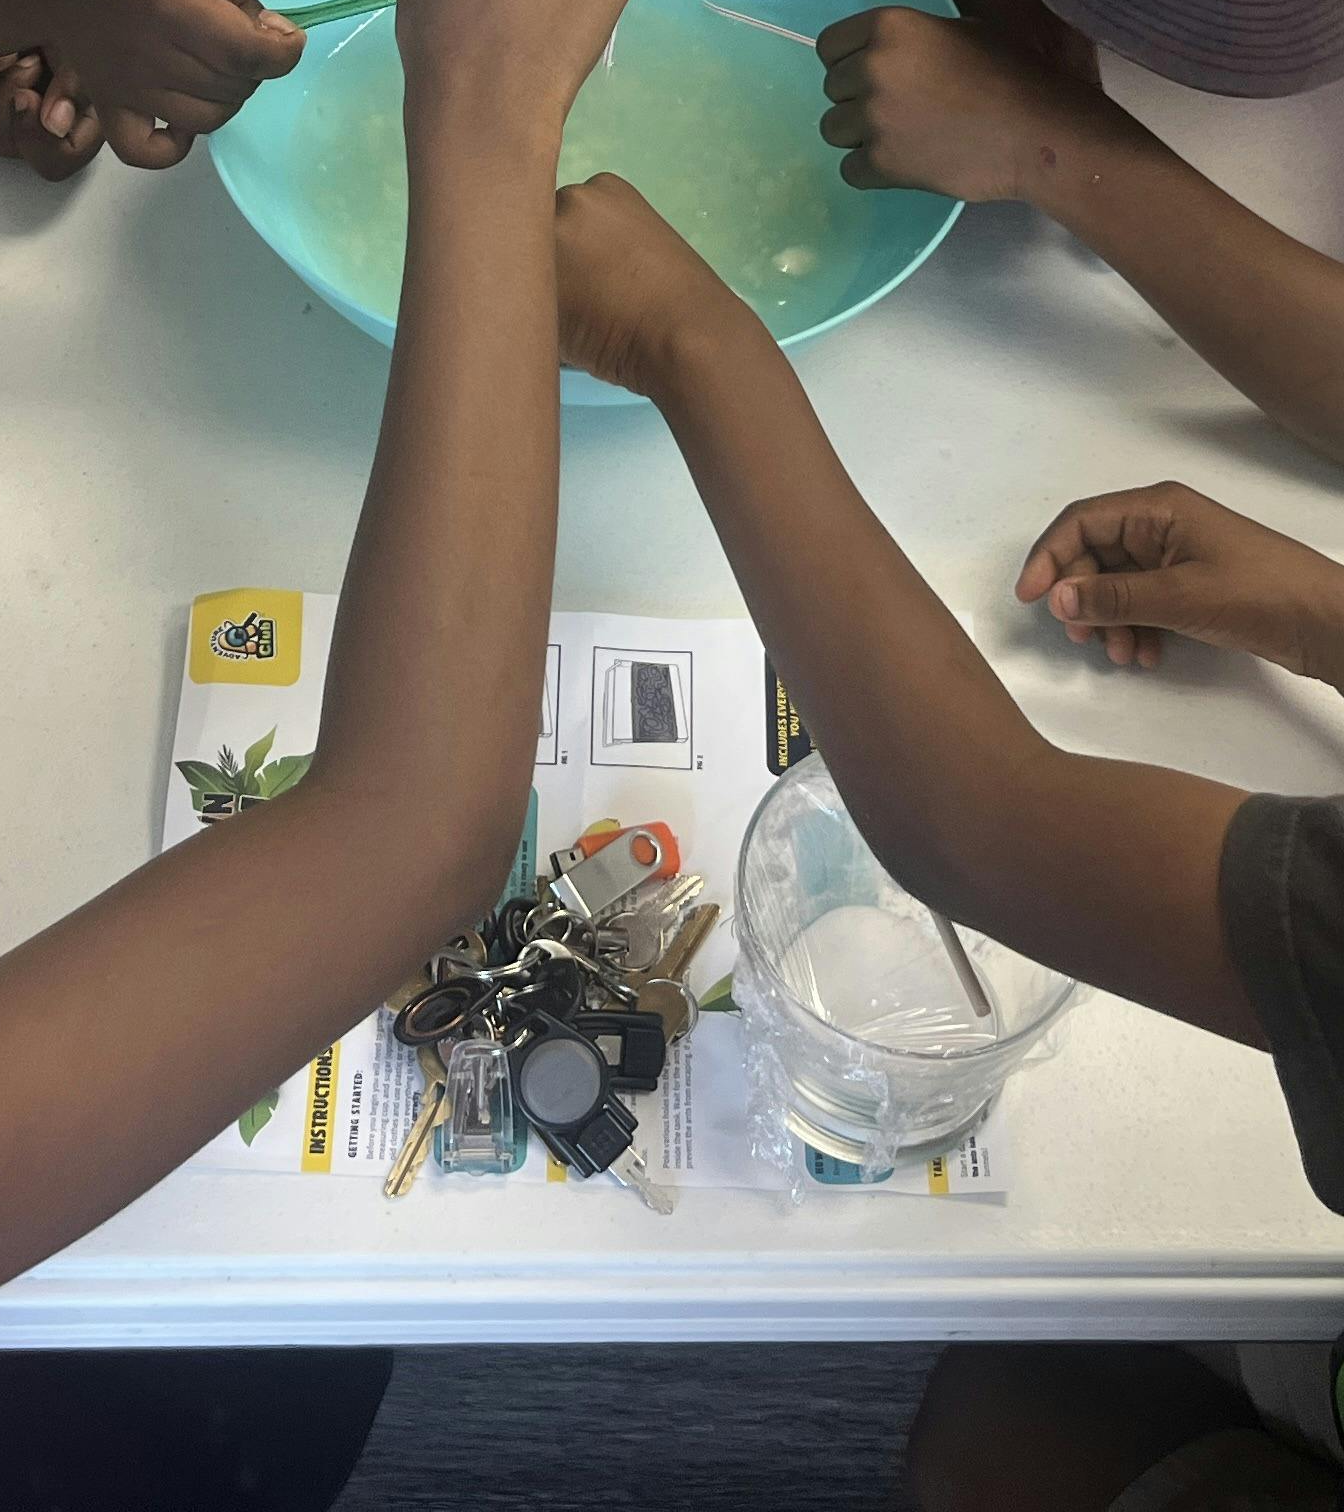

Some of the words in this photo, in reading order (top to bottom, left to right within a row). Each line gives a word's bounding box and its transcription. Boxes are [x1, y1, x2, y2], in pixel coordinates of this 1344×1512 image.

[776, 676, 787, 717] EVERY
[777, 719, 788, 767] INCLUDES
[348, 1119, 359, 1158] GETTING
[932, 1157, 943, 1178] TAK
